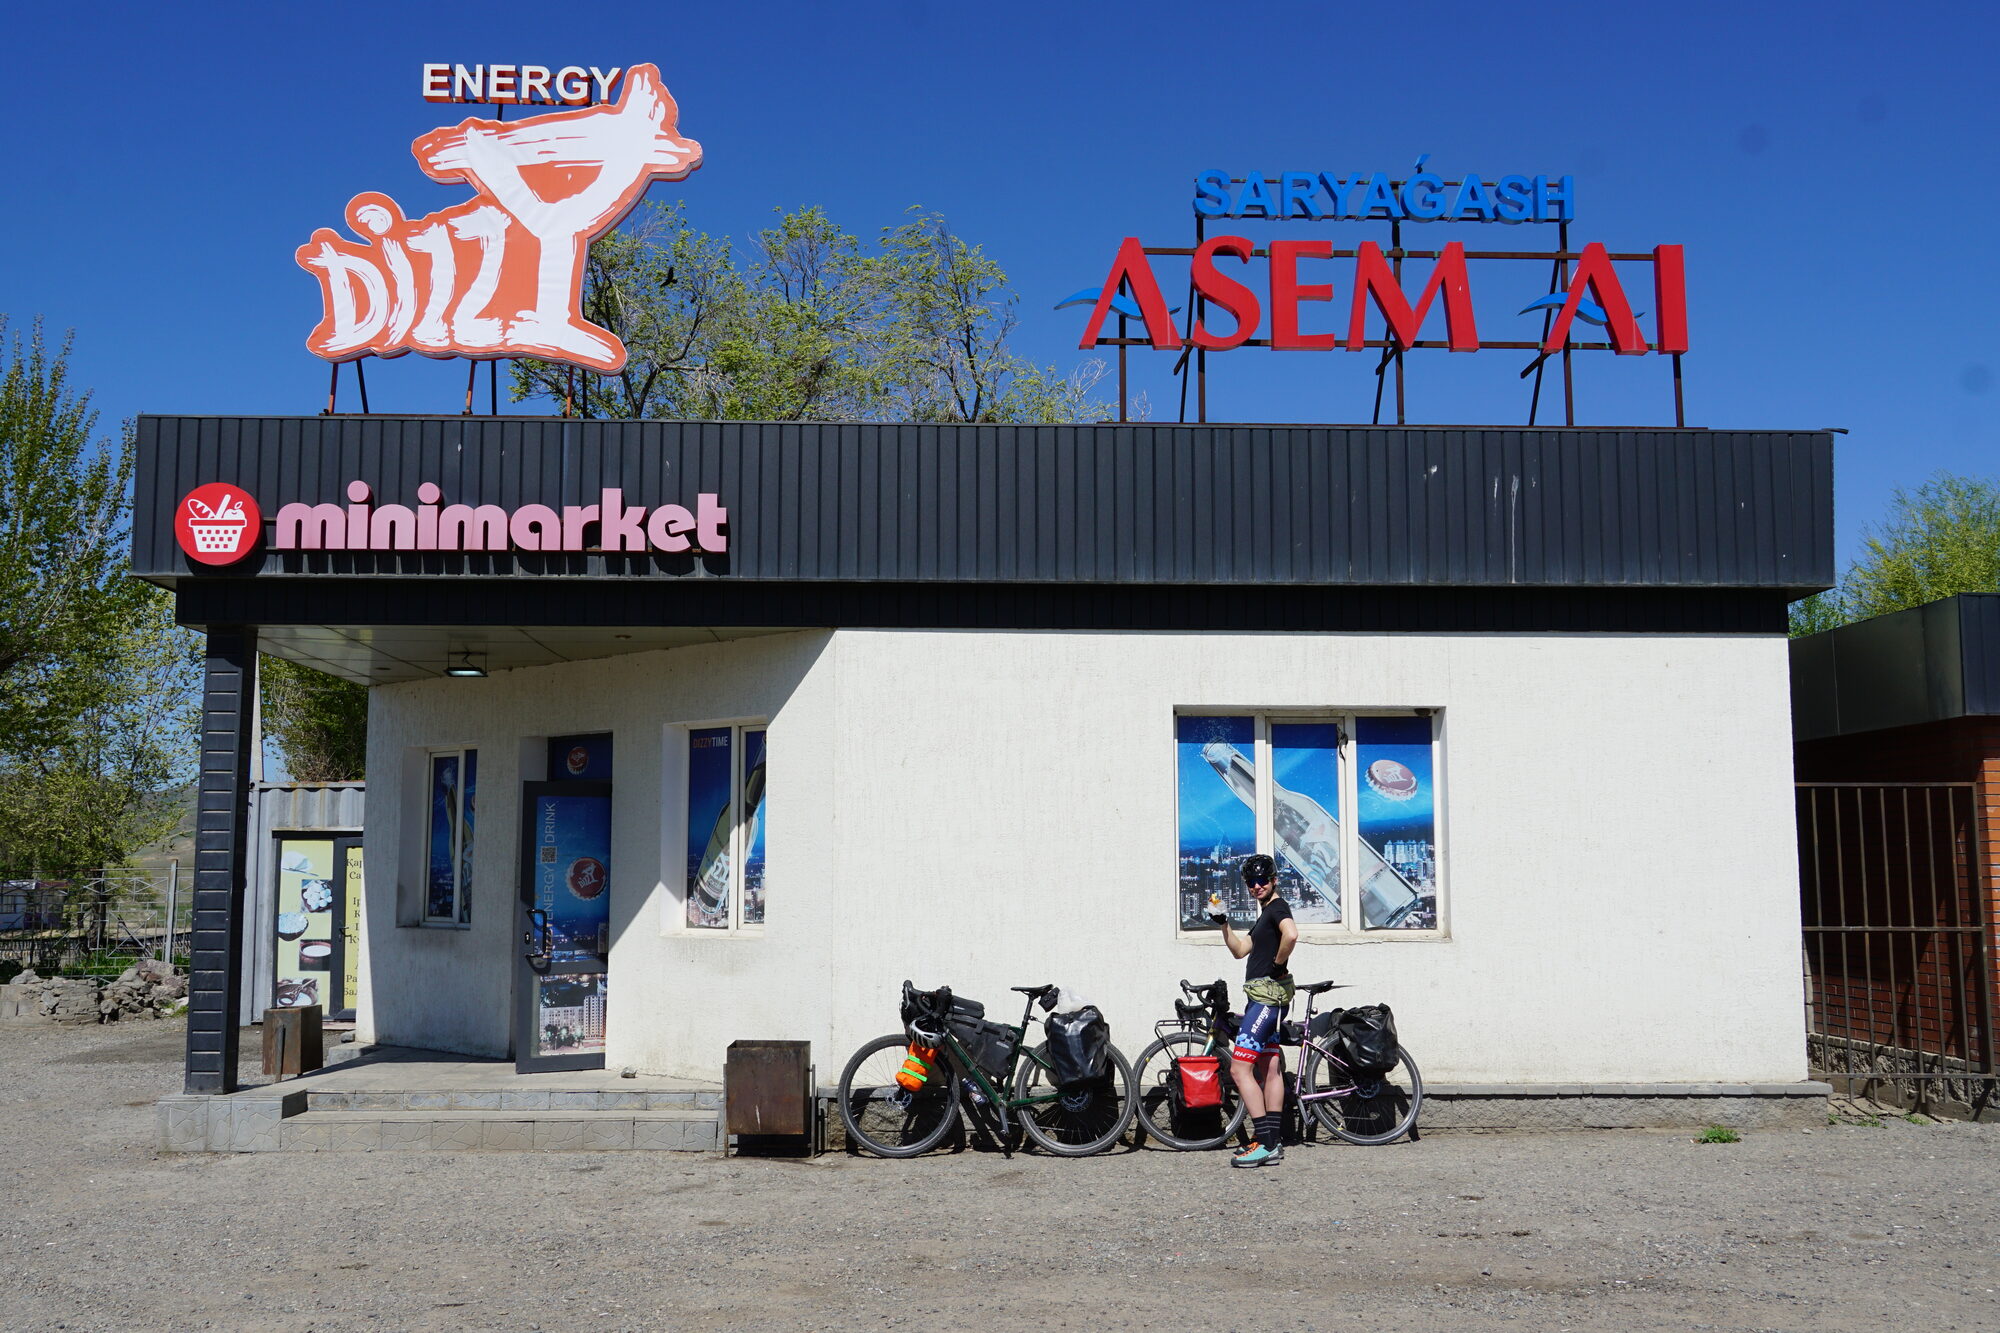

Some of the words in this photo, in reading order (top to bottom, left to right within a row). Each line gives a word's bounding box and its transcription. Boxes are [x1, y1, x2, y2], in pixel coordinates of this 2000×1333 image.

[422, 63, 622, 104] ENERGY
[1079, 236, 1478, 353] ASEM
[1544, 243, 1688, 356] AI
[276, 480, 728, 553] minimarket
[544, 802, 556, 843] DRINK
[543, 867, 555, 921] ENERGY
